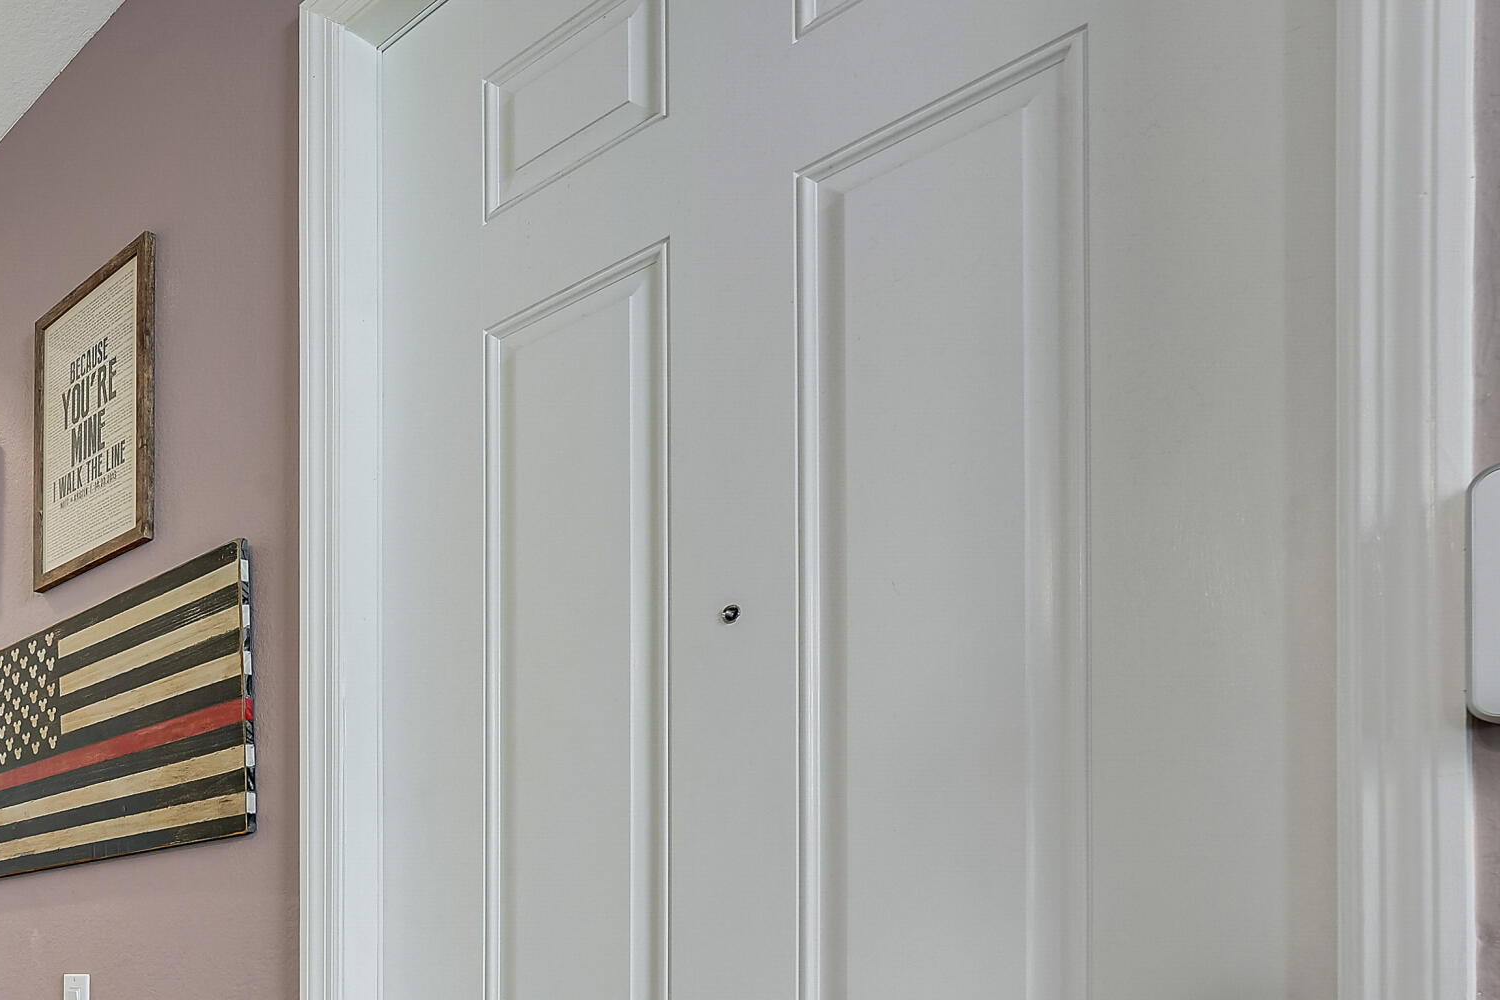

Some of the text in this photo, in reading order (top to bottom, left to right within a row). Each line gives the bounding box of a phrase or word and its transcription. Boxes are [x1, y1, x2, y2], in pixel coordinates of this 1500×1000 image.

[69, 336, 109, 384] BECAUSE
[61, 356, 117, 430] YOU'RE
[71, 409, 106, 468] MINE
[53, 481, 57, 503] I
[58, 465, 83, 499] WALK
[86, 453, 103, 483] THE
[106, 439, 126, 472] LINE
